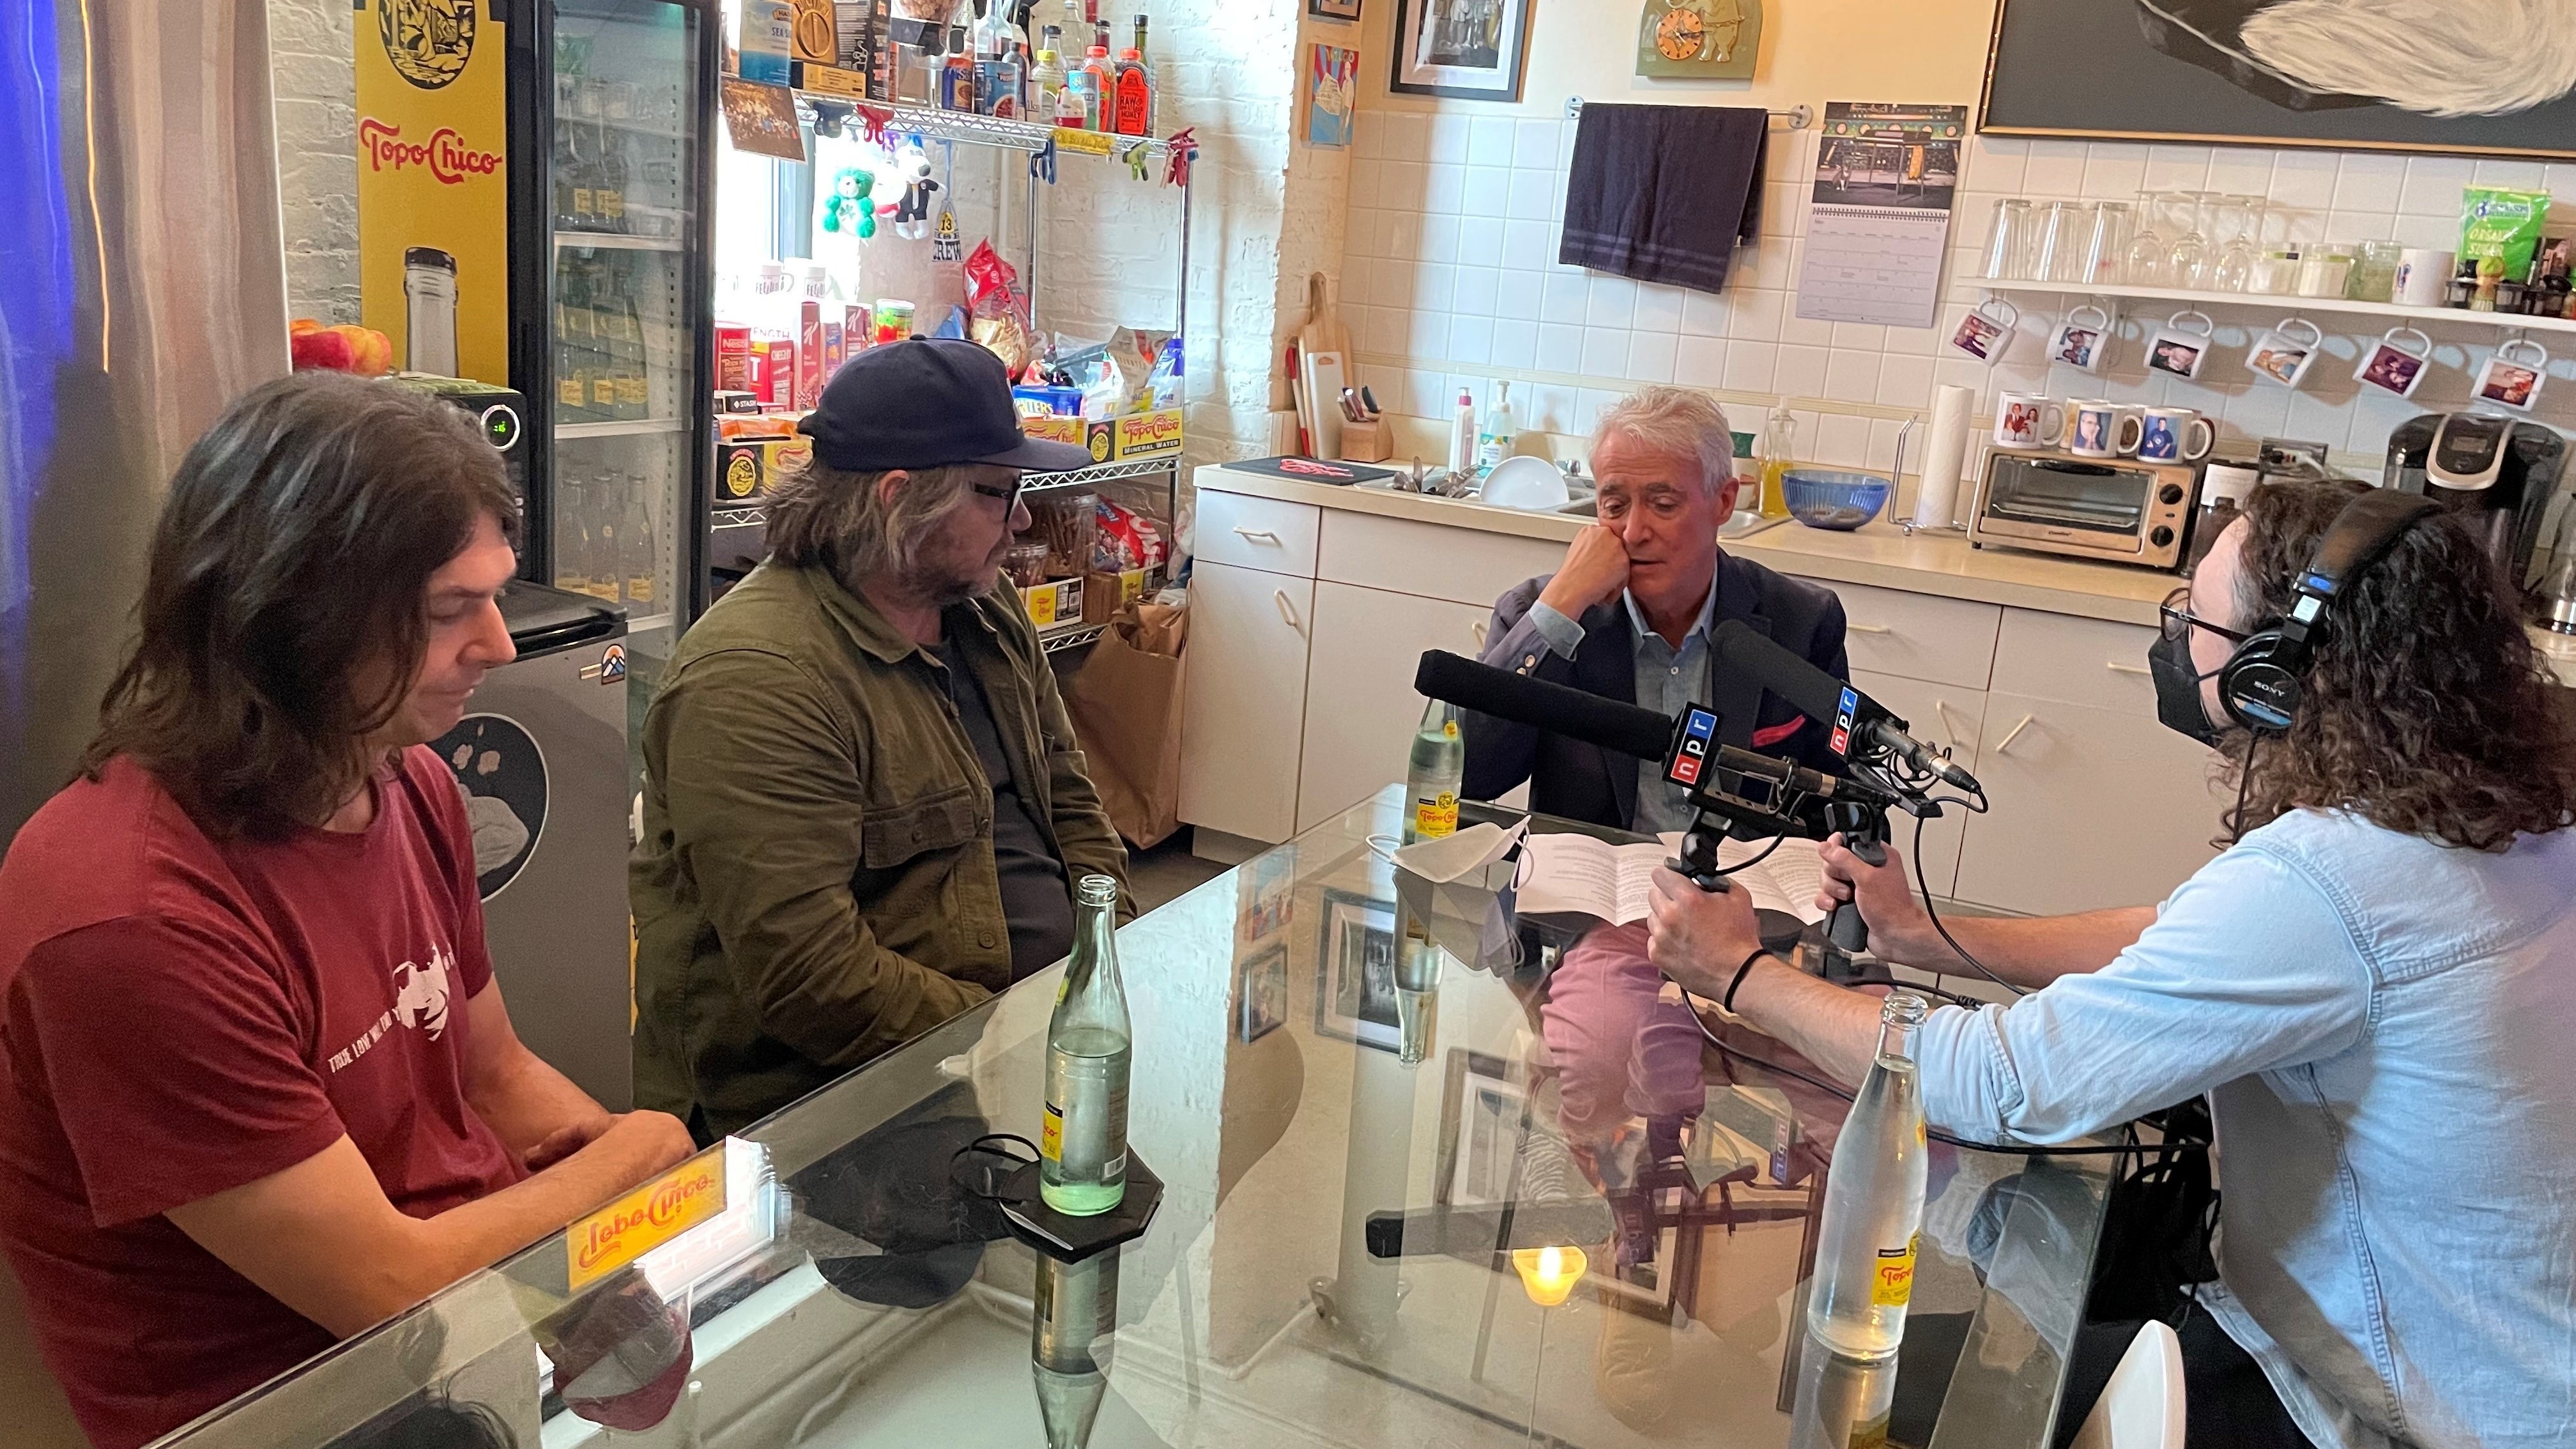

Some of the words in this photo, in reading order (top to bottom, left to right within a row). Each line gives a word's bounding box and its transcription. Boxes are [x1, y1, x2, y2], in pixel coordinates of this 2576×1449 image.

[1119, 95, 1137, 106] RAW
[360, 118, 427, 172] Topo
[428, 128, 503, 185] Chico
[940, 218, 953, 231] 13
[753, 326, 790, 340] ENGTH
[1122, 417, 1154, 445] Topo
[1152, 414, 1180, 440] Chico
[1124, 444, 1155, 454] MINERAL
[1155, 440, 1179, 449] WATER
[2253, 680, 2286, 698] SONY
[1833, 694, 1854, 749] npr
[1676, 716, 1710, 778] npr
[1420, 809, 1444, 823] Topo
[328, 1047, 353, 1073] TRUE
